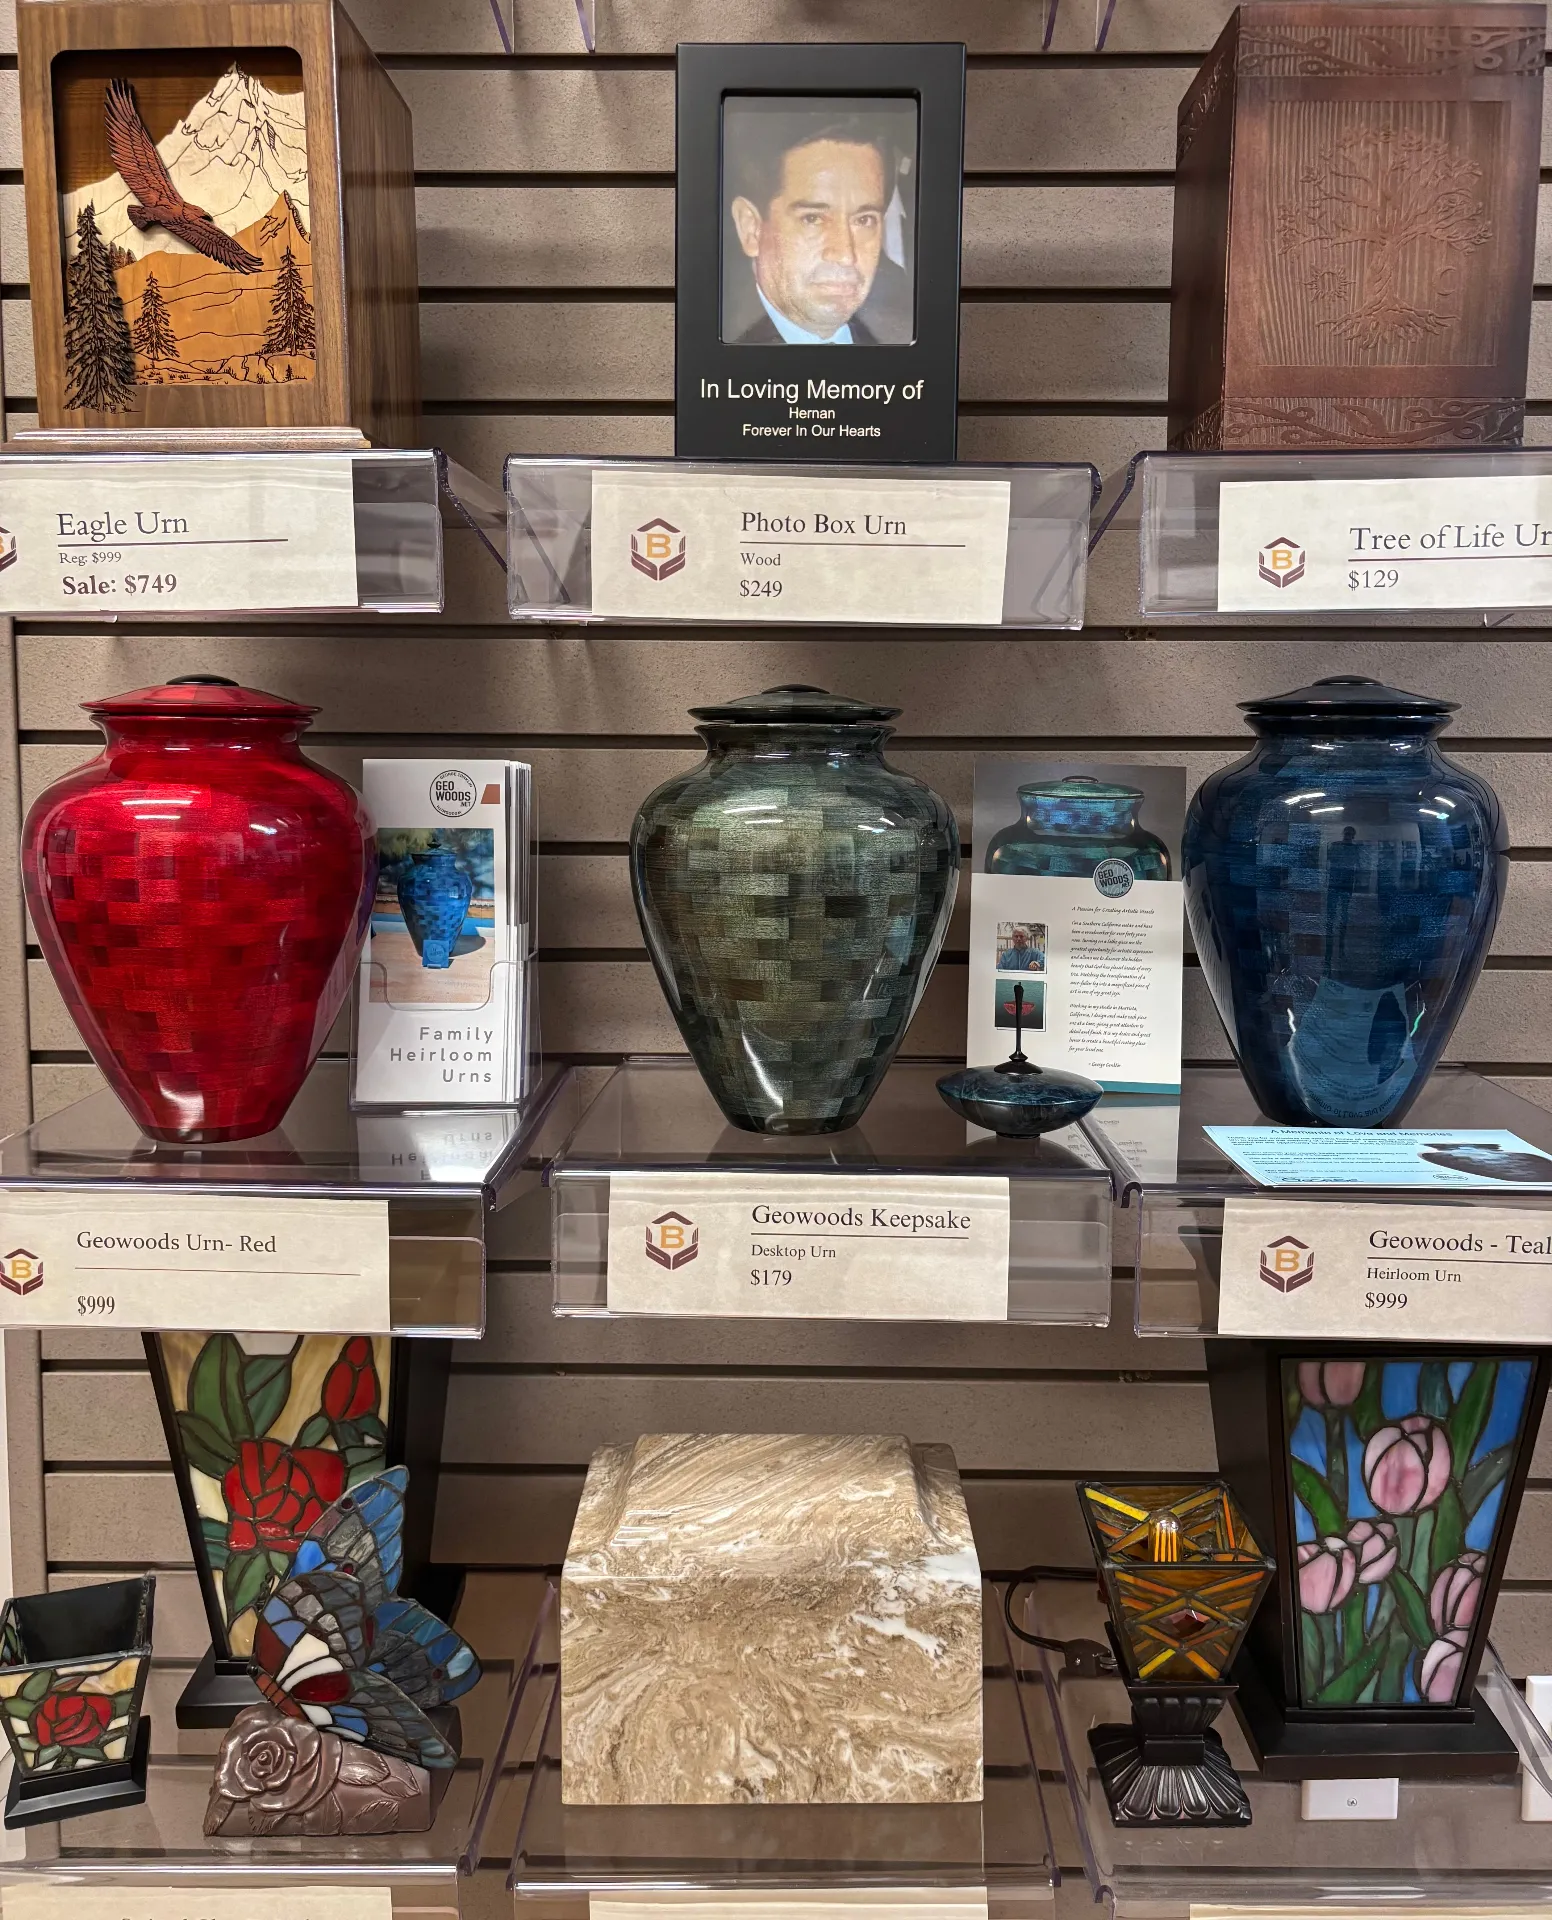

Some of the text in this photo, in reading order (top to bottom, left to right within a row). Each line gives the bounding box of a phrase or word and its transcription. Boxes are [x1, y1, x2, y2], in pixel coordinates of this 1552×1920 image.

[700, 379, 925, 404] In Loving Memory of
[789, 407, 836, 419] Hernan
[742, 424, 881, 437] Forever In Our Hearts
[57, 511, 189, 541] Eagle Urn
[741, 511, 908, 536] Photo Box Urn
[646, 533, 672, 558] B
[1349, 523, 1552, 550] Tree of Life Ur
[91, 551, 122, 564] $999
[740, 553, 781, 567] Wood
[1272, 549, 1293, 570] B
[62, 574, 177, 596] Sale: $749
[739, 579, 783, 598] $249
[1348, 569, 1399, 591] $129
[435, 781, 454, 791] GEO
[435, 791, 471, 801] WOODS
[1098, 869, 1113, 879] GEO
[1099, 874, 1129, 887] WOODS
[420, 1027, 493, 1044] Family
[390, 1048, 492, 1062] Heirloom
[443, 1069, 492, 1083] Urns
[752, 1204, 971, 1233] Geowoods Keepsake
[77, 1231, 277, 1253] Geowoods Urn- Red
[660, 1225, 685, 1249] B
[1369, 1230, 1483, 1252] Geowoods
[1505, 1234, 1552, 1255] Teal
[751, 1244, 836, 1260] Desktop Urn
[1275, 1249, 1300, 1272] B
[11, 1259, 33, 1279] B
[750, 1269, 793, 1288] $179
[1367, 1267, 1462, 1283] Heirloom Urn
[77, 1295, 116, 1316] $999
[1364, 1292, 1408, 1310] $999
